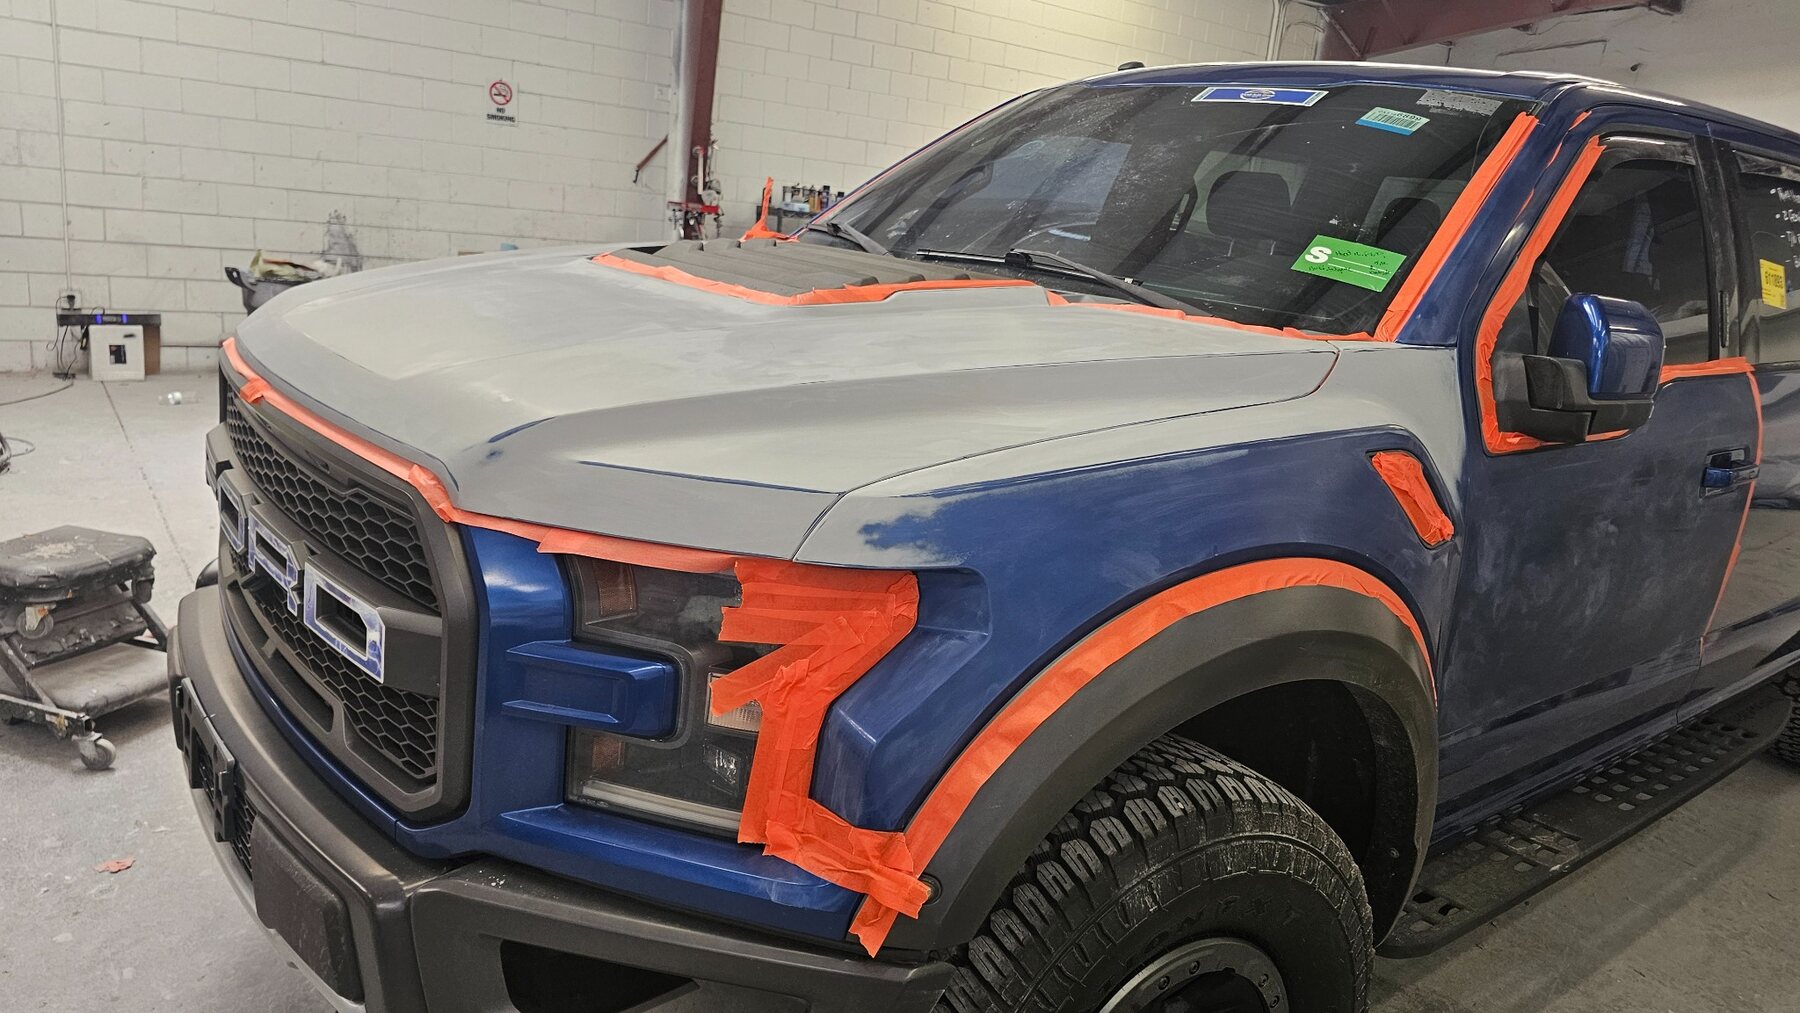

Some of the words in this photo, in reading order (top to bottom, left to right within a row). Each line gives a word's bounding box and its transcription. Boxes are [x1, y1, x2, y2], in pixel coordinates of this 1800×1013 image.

[486, 113, 516, 123] SMOKING
[1304, 246, 1333, 263] S
[217, 476, 386, 684] ORD
